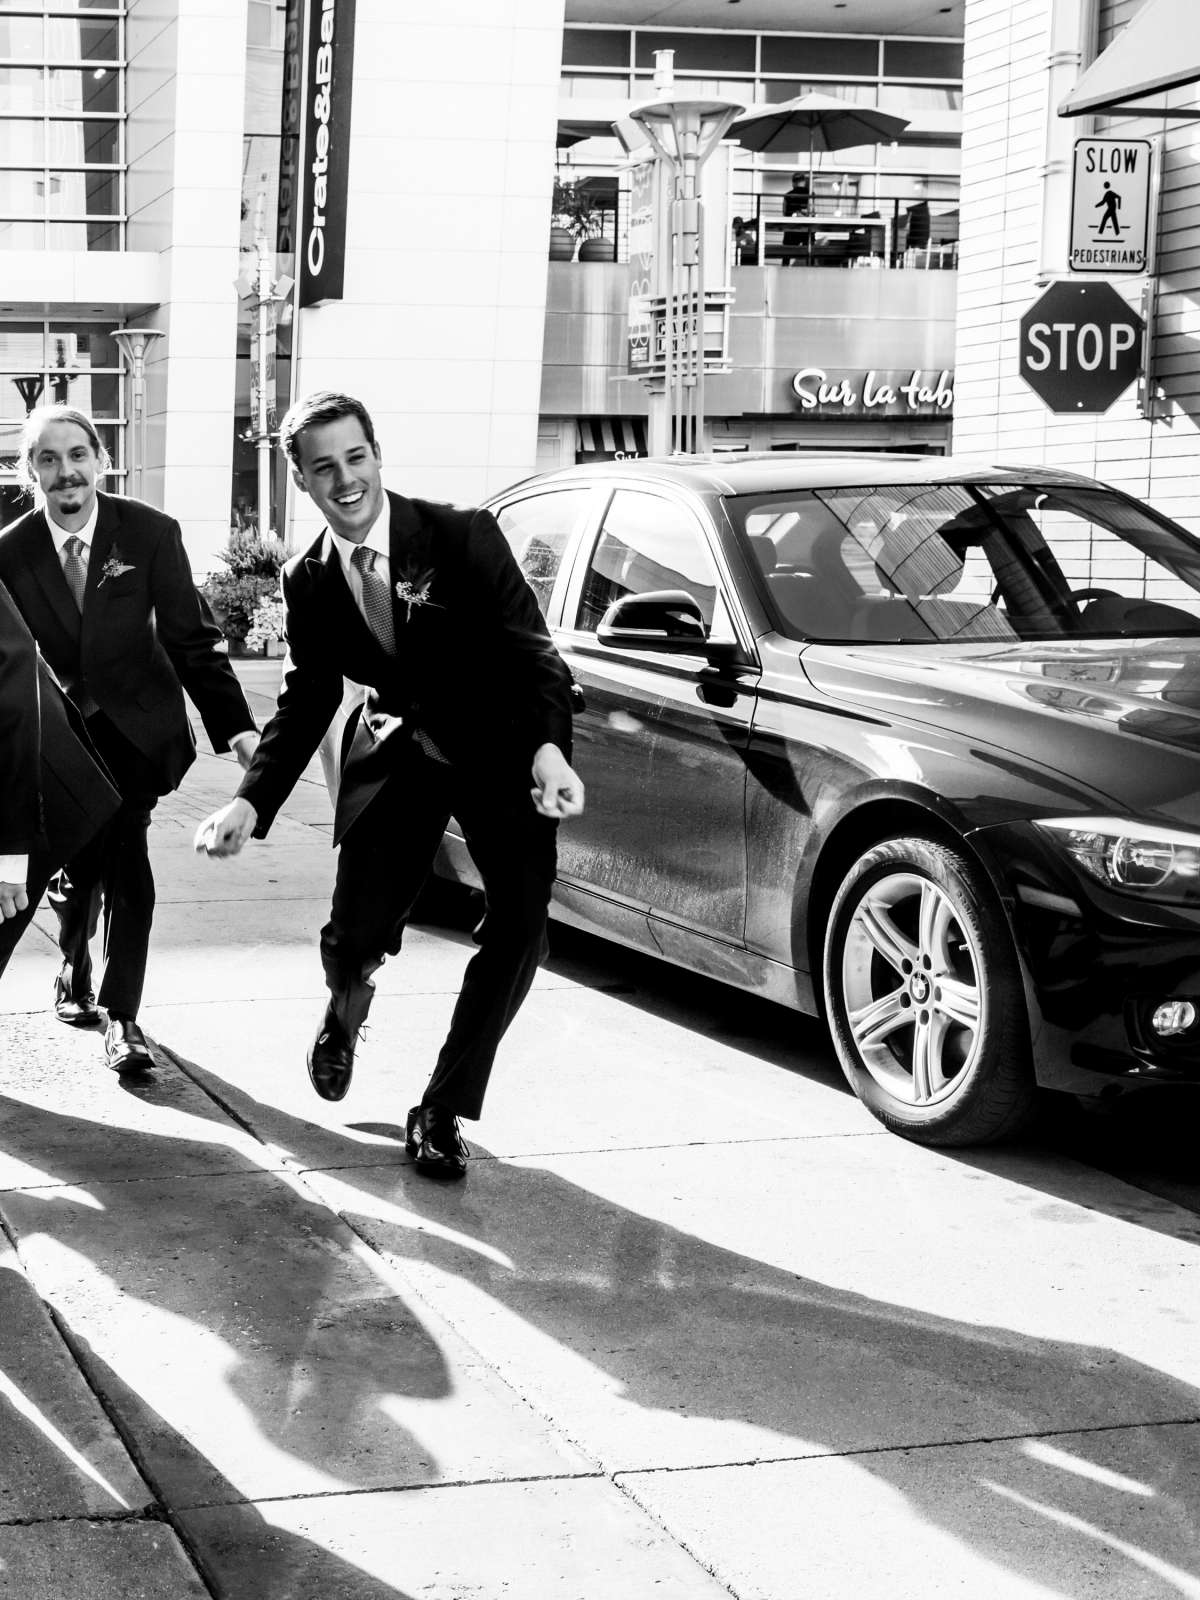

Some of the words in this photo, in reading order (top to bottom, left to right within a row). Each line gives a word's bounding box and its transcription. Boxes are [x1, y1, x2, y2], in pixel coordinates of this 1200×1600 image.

[1086, 147, 1138, 173] SLOW
[1073, 249, 1143, 264] PEDESTRIANS
[1026, 323, 1136, 371] STOP
[793, 368, 857, 409] Sur
[863, 370, 897, 408] la
[900, 369, 954, 410] tab
